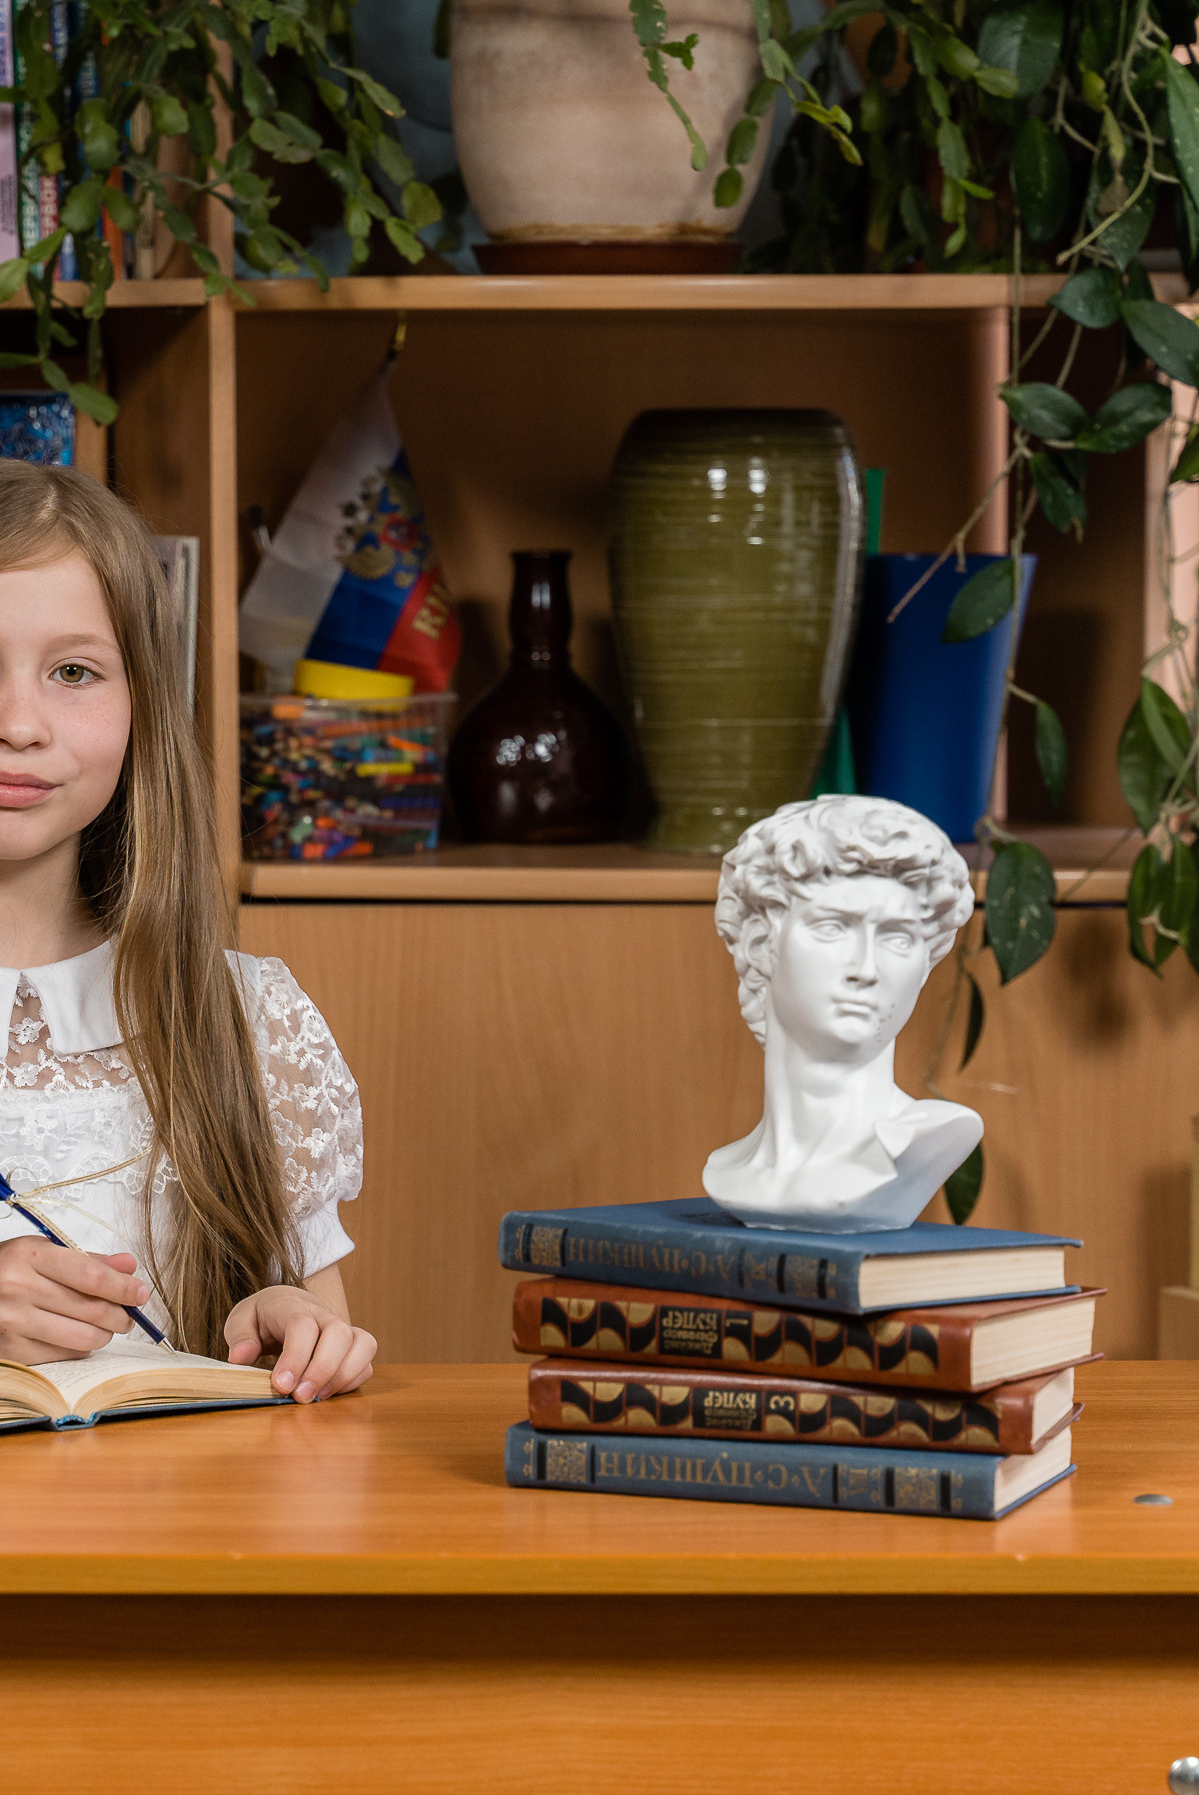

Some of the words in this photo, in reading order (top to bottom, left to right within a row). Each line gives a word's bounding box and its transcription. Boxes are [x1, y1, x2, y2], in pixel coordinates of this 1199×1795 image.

[662, 1310, 719, 1329] КУПЕР
[703, 1391, 757, 1409] КУПЕР
[769, 1394, 796, 1411] 3
